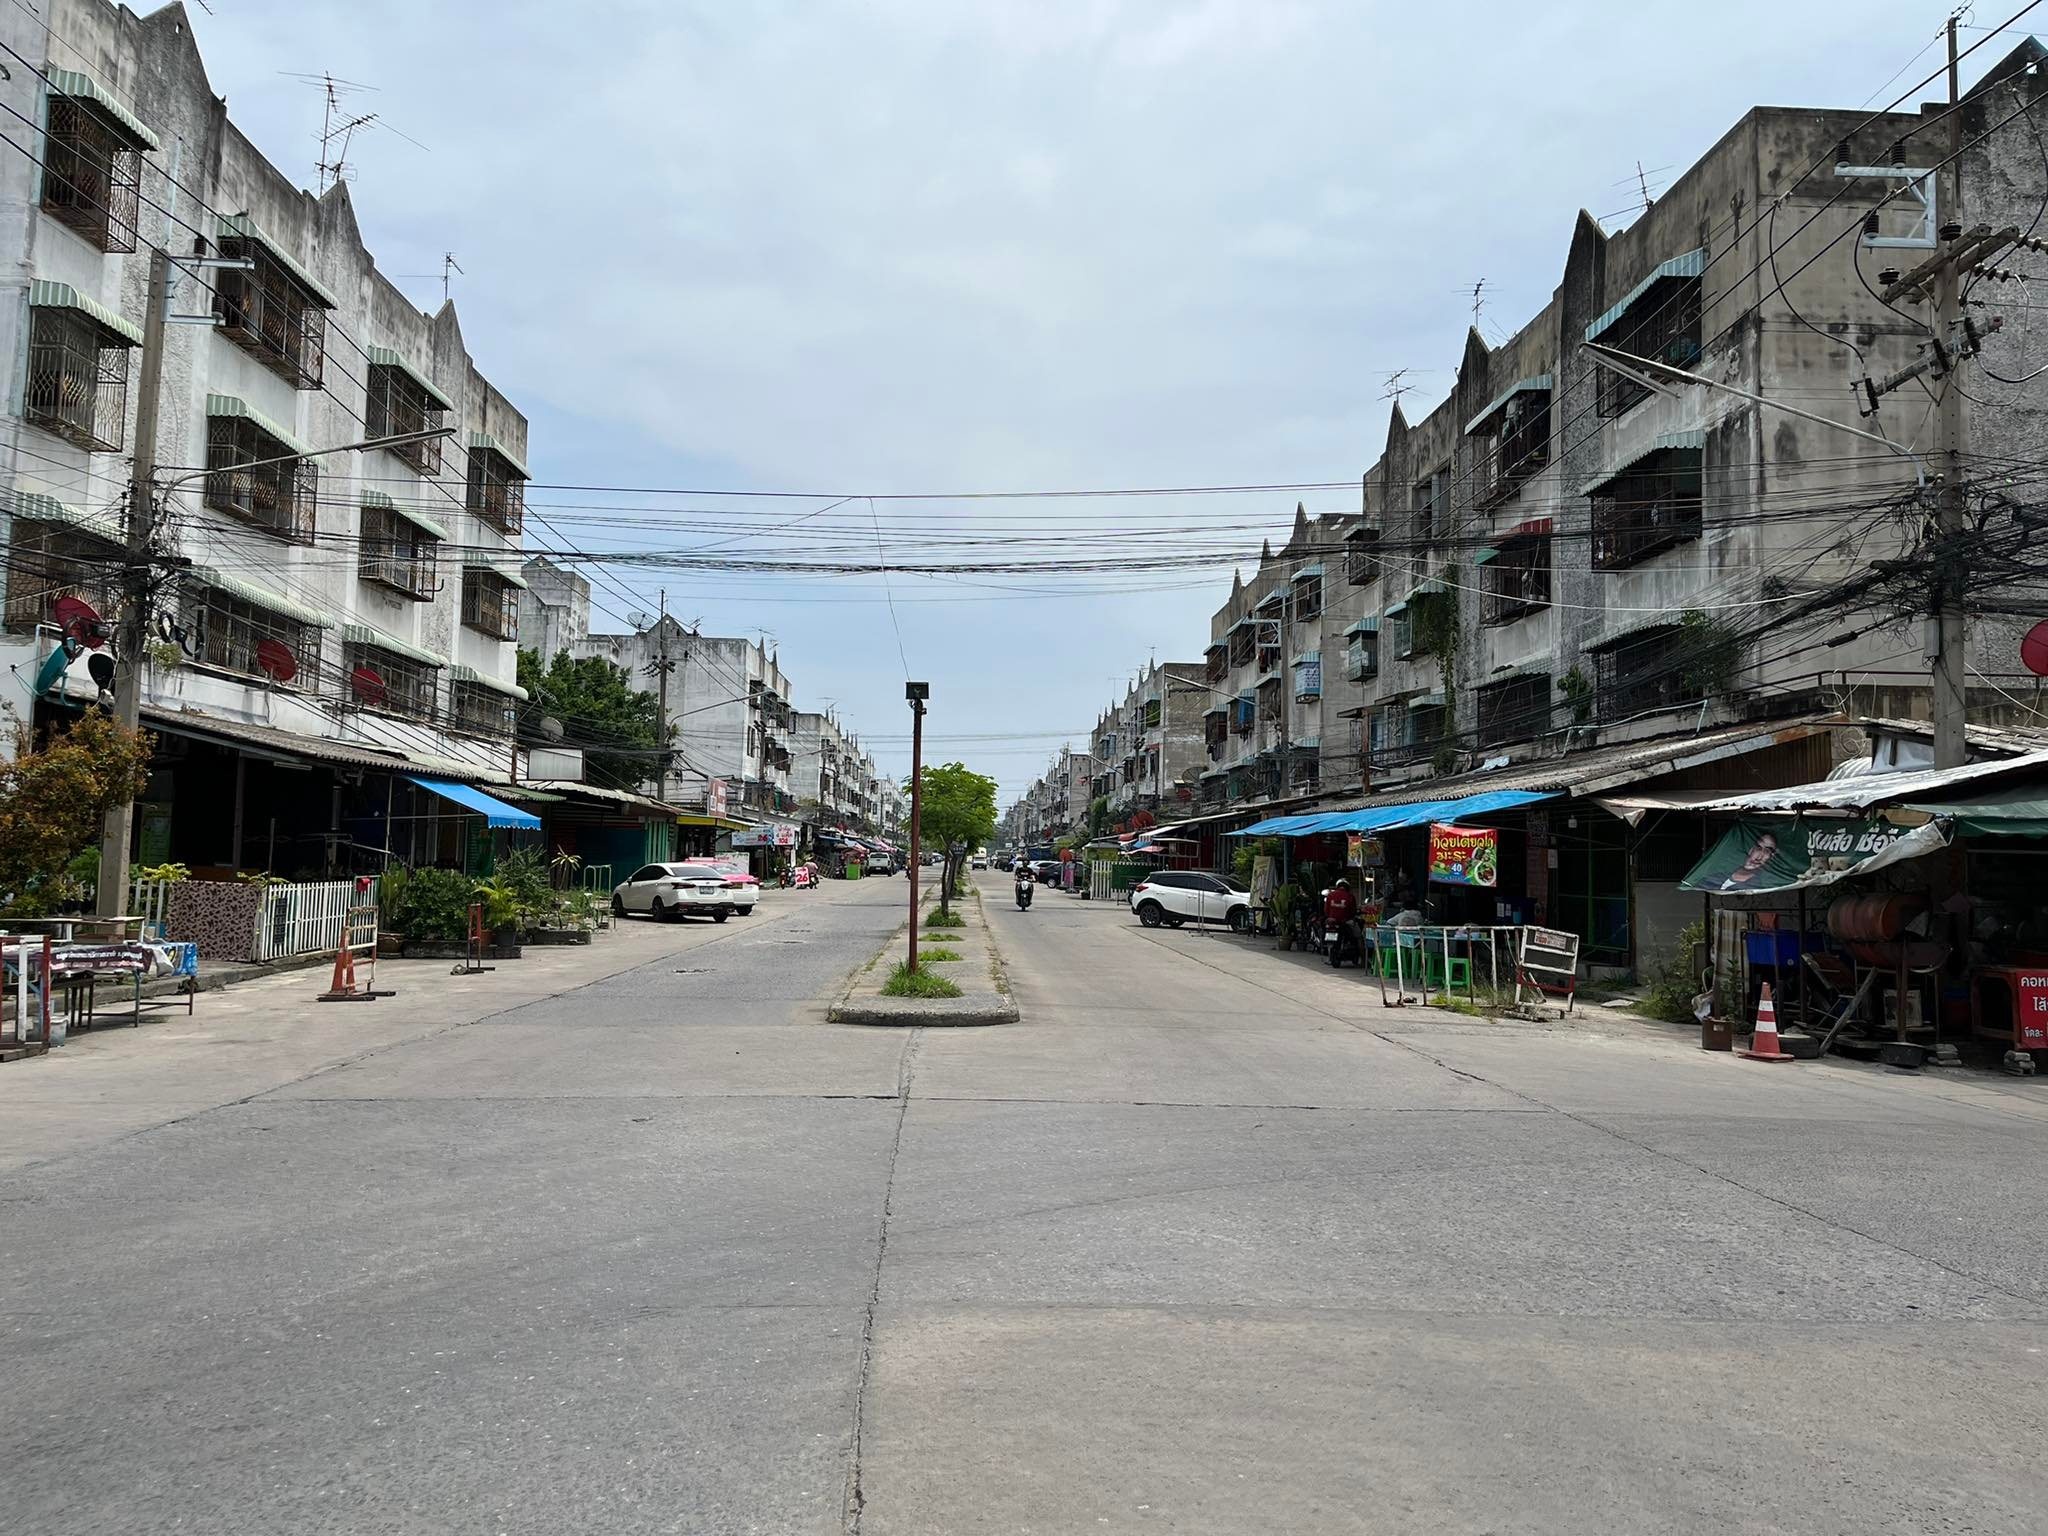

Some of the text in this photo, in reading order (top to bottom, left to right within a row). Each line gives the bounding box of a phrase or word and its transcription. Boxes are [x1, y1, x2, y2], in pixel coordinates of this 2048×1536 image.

[1436, 850, 1467, 861] มะระ
[1451, 863, 1463, 872] 40
[796, 873, 808, 882] 26
[2021, 976, 2048, 987] คอห
